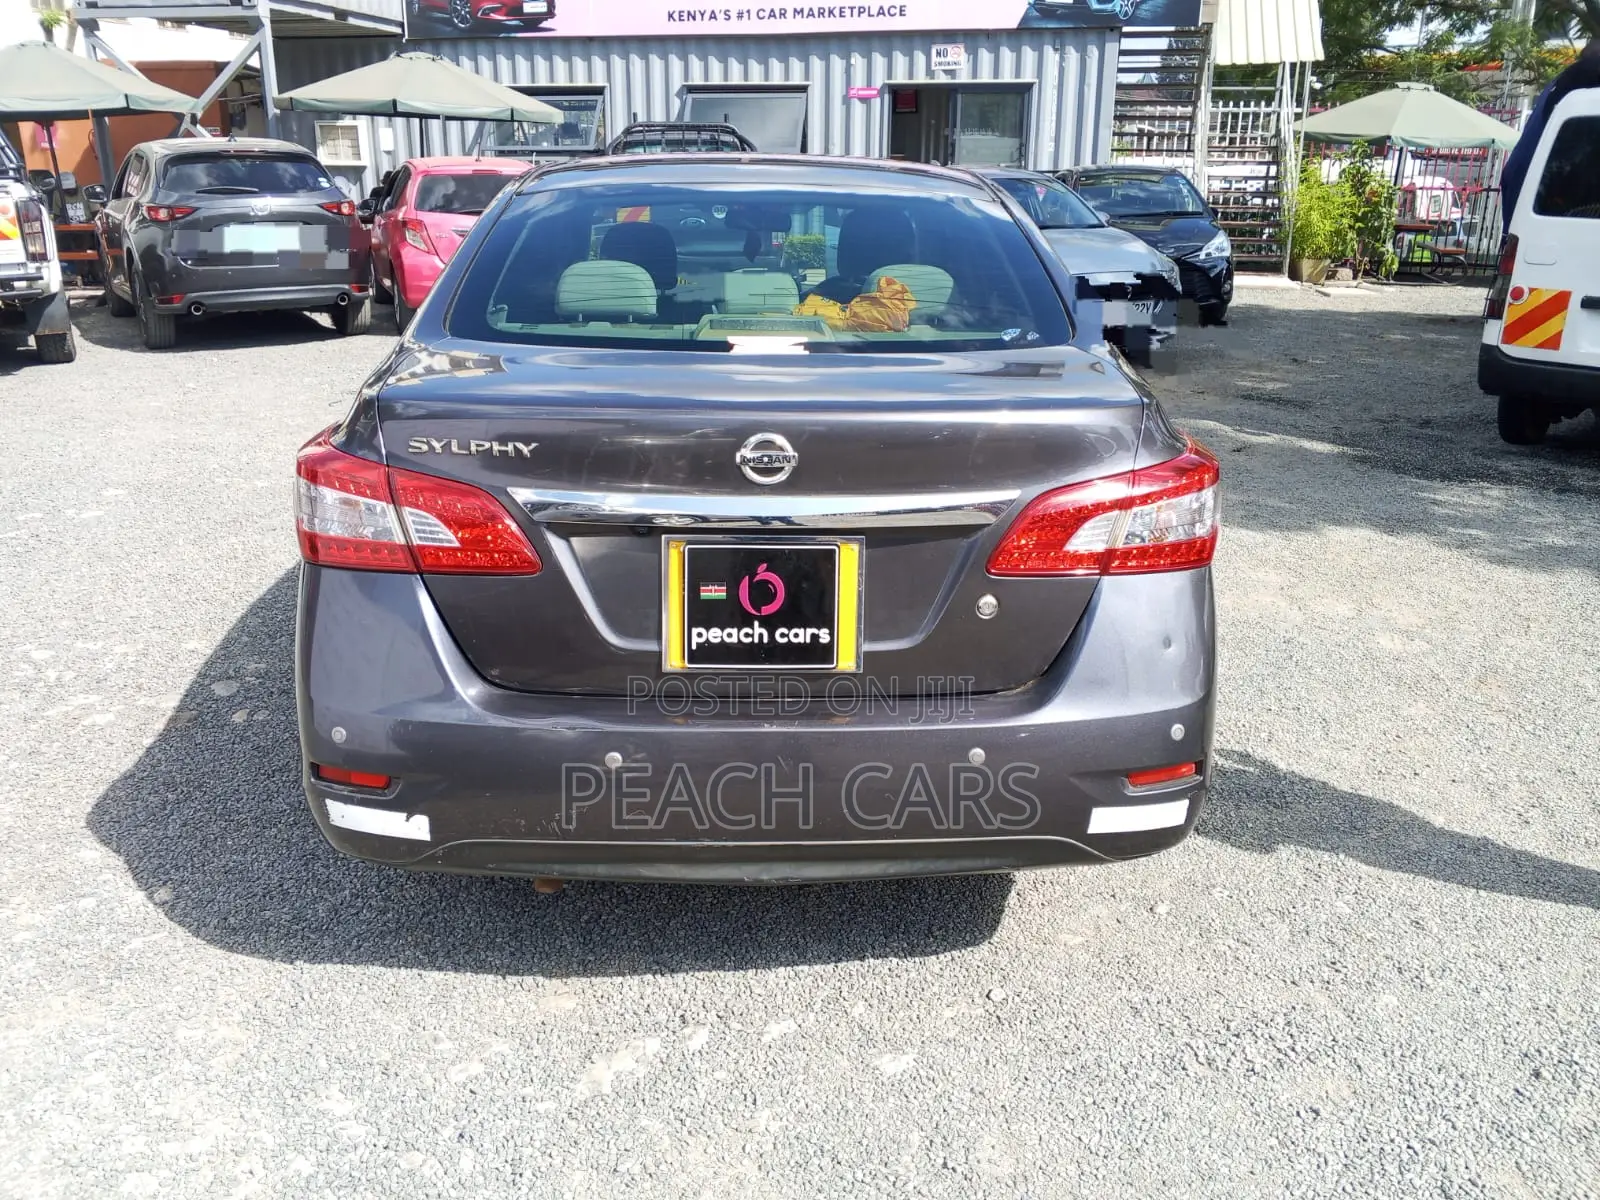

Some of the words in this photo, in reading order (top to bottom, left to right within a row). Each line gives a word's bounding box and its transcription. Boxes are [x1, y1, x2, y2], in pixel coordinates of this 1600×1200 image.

[667, 9, 731, 22] KENYA'S
[736, 9, 751, 21] #1
[756, 8, 788, 20] CAR
[793, 5, 907, 19] MARKETPLACE
[935, 47, 949, 58] NO
[408, 437, 539, 457] SYLPHY
[742, 454, 792, 465] NISSAN
[691, 620, 768, 650] peach
[774, 626, 831, 644] cars
